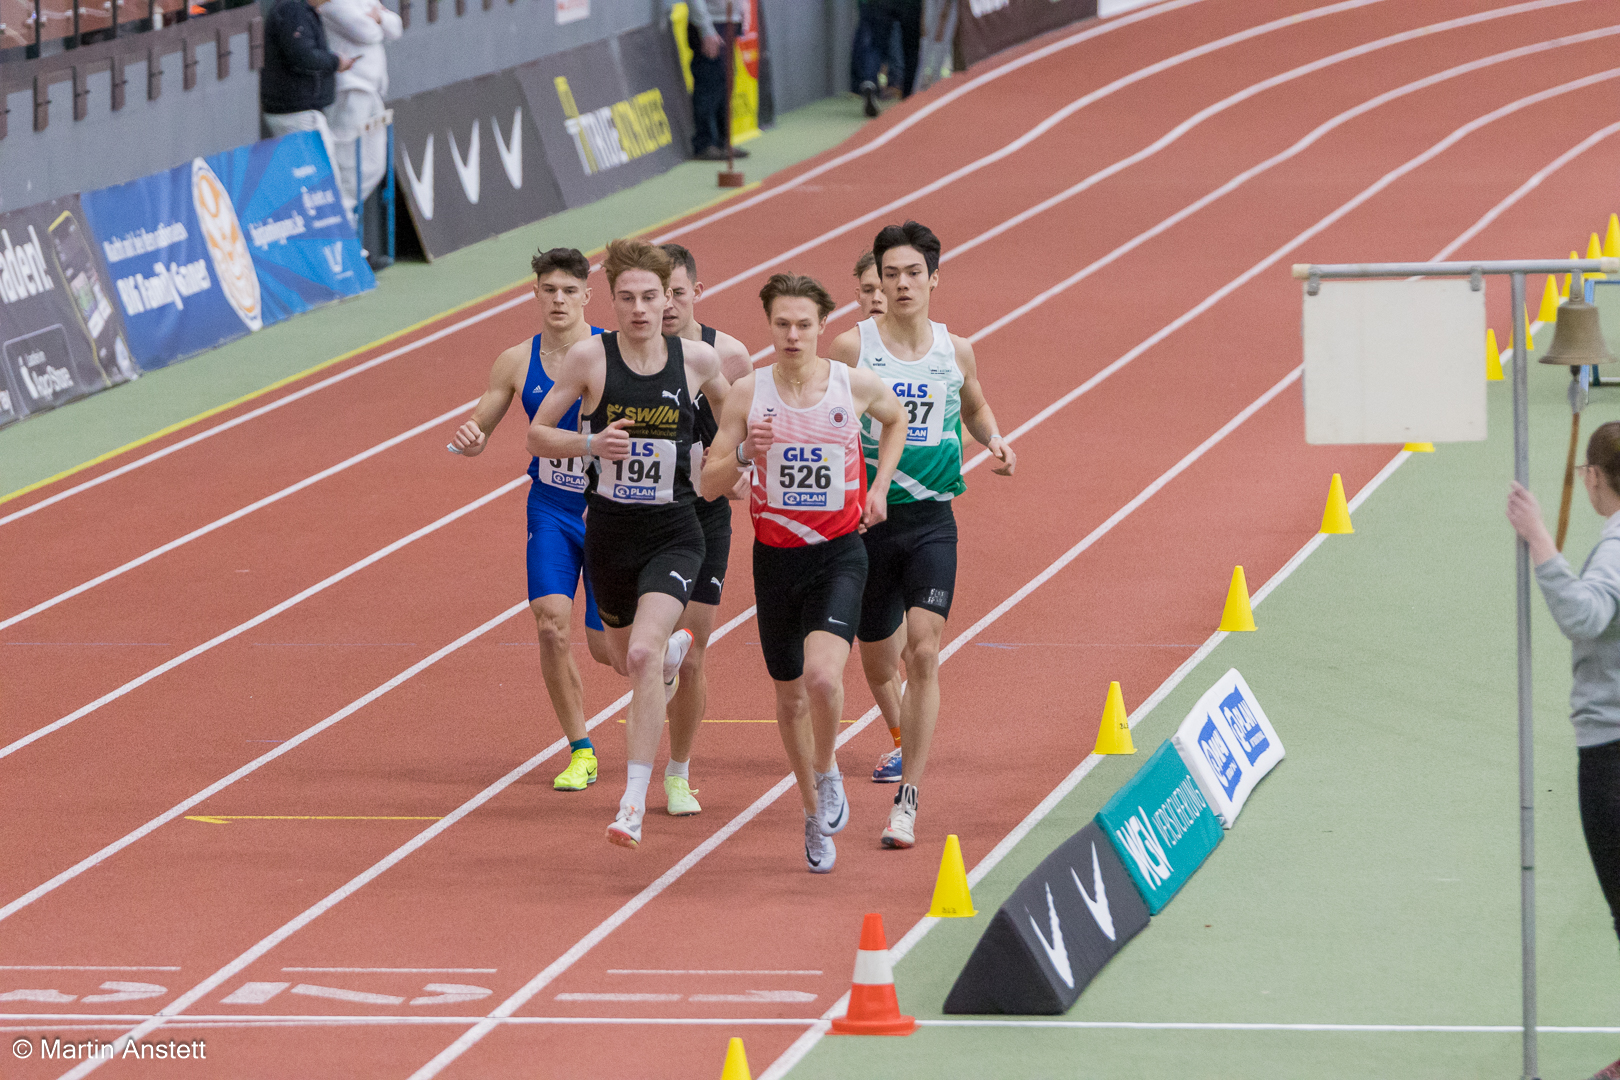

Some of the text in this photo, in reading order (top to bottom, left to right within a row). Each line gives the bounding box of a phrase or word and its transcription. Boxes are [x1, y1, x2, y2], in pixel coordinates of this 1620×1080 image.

[612, 459, 662, 483] 194
[779, 464, 831, 490] 526
[630, 488, 655, 496] PLAN
[801, 494, 825, 502] PLAN
[1116, 775, 1208, 891] WGV VERSICHERUNG
